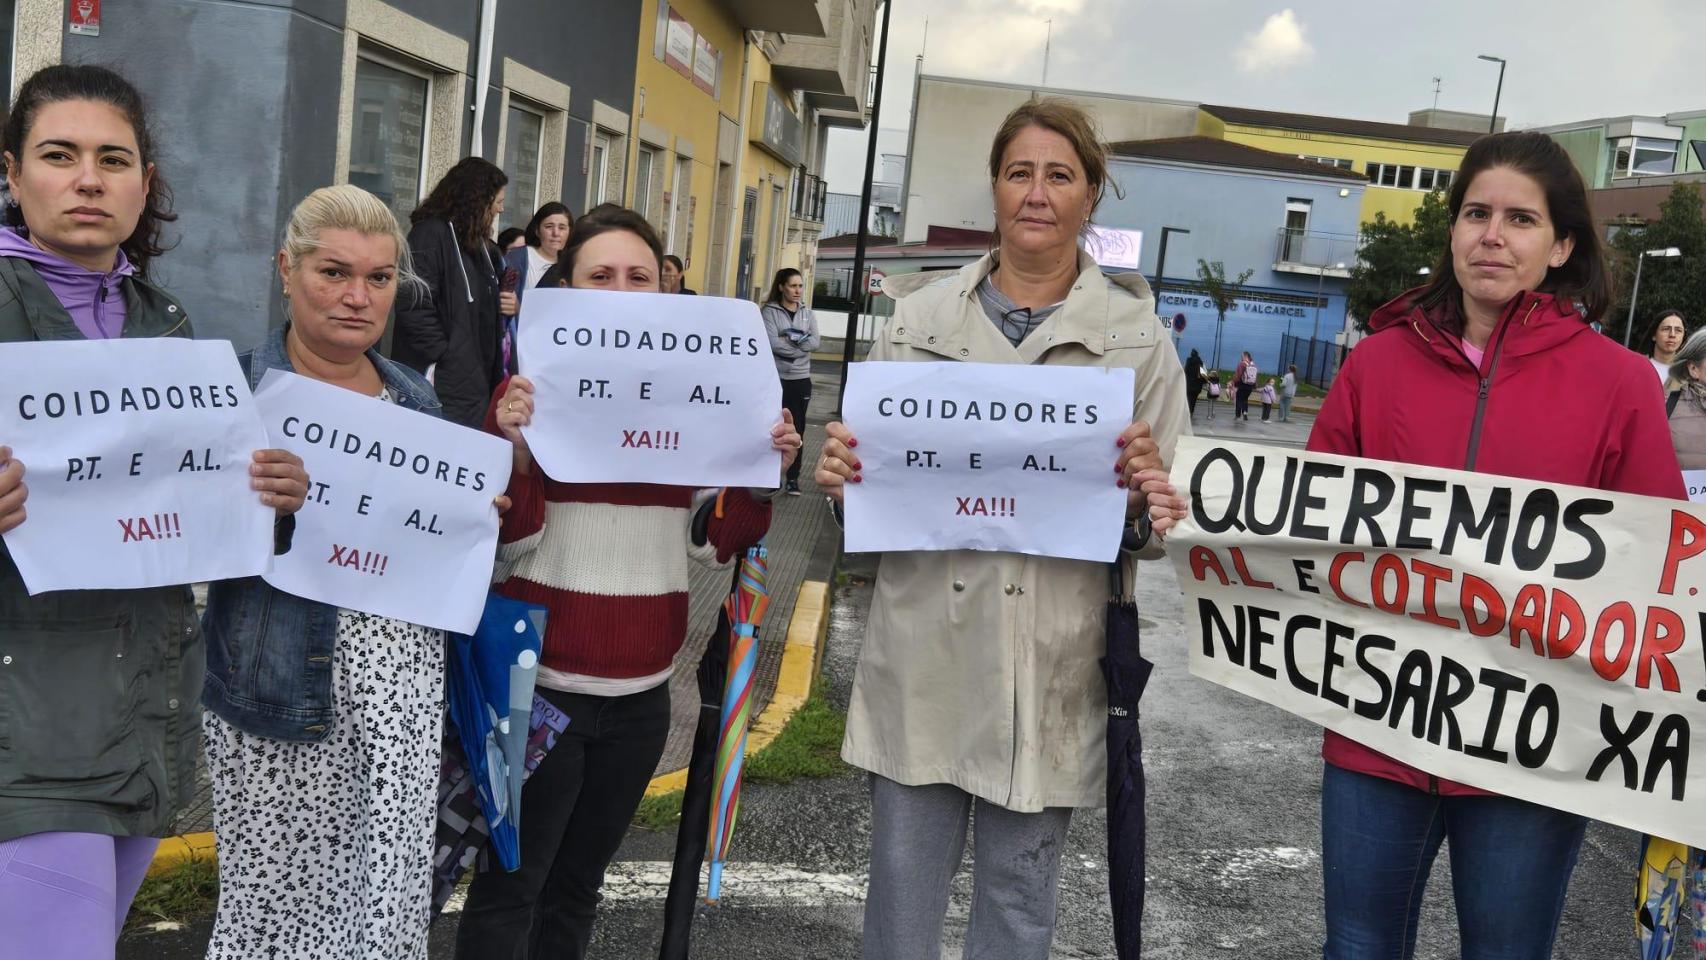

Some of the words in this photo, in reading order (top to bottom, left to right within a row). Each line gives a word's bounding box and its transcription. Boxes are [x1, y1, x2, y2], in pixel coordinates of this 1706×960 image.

[1244, 302, 1306, 317] VALCARCEL
[553, 328, 757, 356] COIDADORES
[19, 385, 238, 420] COIDADORES
[579, 379, 612, 398] P.T.
[640, 382, 651, 399] E
[689, 385, 730, 404] A.L.
[879, 398, 1097, 424] COIDADORES
[282, 416, 487, 491] COIDADORES
[621, 430, 680, 450] XA!!!
[66, 456, 101, 481] P.T.
[129, 453, 143, 476] E
[179, 449, 220, 472] A.L.
[907, 450, 941, 468] P.T.
[970, 453, 982, 469] E
[1022, 455, 1066, 472] A.L.
[307, 480, 331, 505] .T.
[358, 495, 372, 515] E
[405, 509, 442, 535] A.L.
[955, 497, 1015, 516] XA!!!
[1189, 447, 1614, 580] QUEREMOS
[118, 513, 182, 542] XA!!!
[328, 544, 390, 577] XA!!!
[1189, 545, 1284, 592] A.L.
[1293, 559, 1321, 595] E
[1198, 597, 1560, 769] NECESARIO
[1585, 704, 1690, 801] XA
